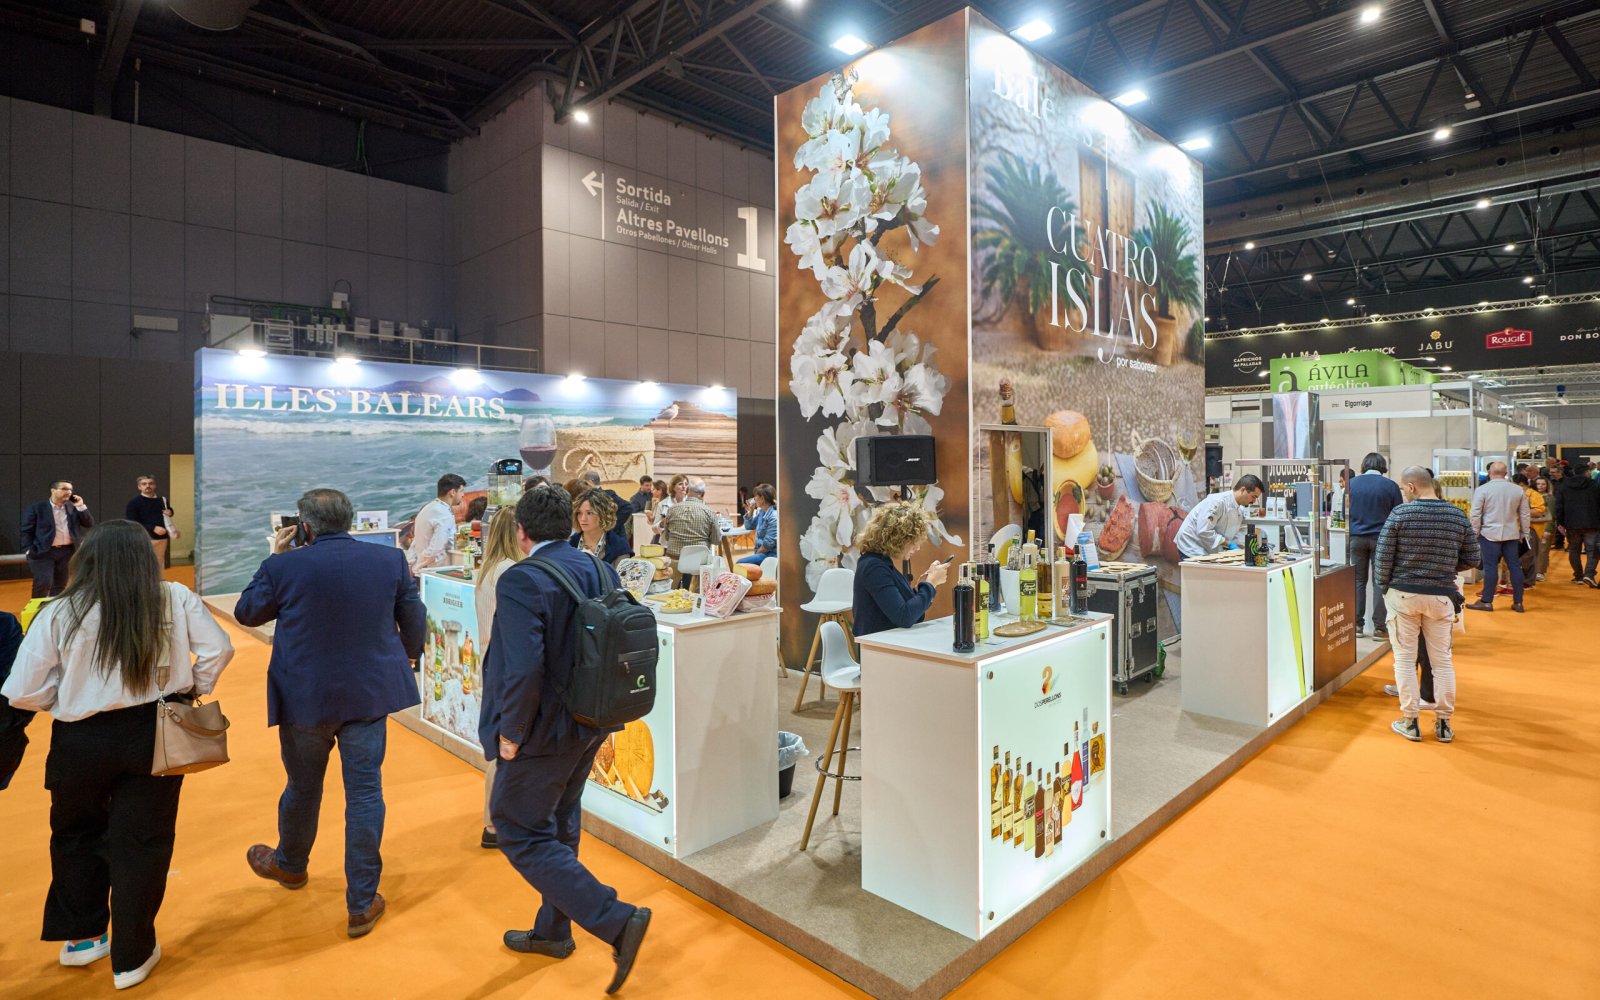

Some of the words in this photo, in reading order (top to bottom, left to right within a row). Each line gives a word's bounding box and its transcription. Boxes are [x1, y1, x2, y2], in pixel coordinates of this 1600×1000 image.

[616, 177, 671, 206] Sortida
[616, 195, 639, 208] Salida
[645, 202, 660, 214] Exit
[616, 225, 637, 238] Otros
[638, 230, 676, 246] Pabellones
[681, 240, 700, 251] Other
[701, 244, 717, 255] Halls
[617, 208, 663, 232] Altres
[666, 220, 729, 248] Pavellons
[737, 206, 766, 272] 1
[1046, 206, 1158, 287] CUATRO
[1048, 260, 1158, 364] ISLAS
[1418, 341, 1453, 352] JABU
[1560, 333, 1582, 341] DON
[1586, 332, 1600, 340] BO
[1116, 356, 1128, 370] por
[1128, 357, 1158, 373] saborear
[1309, 363, 1369, 381] ÁVILA
[214, 383, 338, 414] ILLES
[349, 390, 506, 420] BALEARS
[1344, 400, 1372, 408] Elgorriaga
